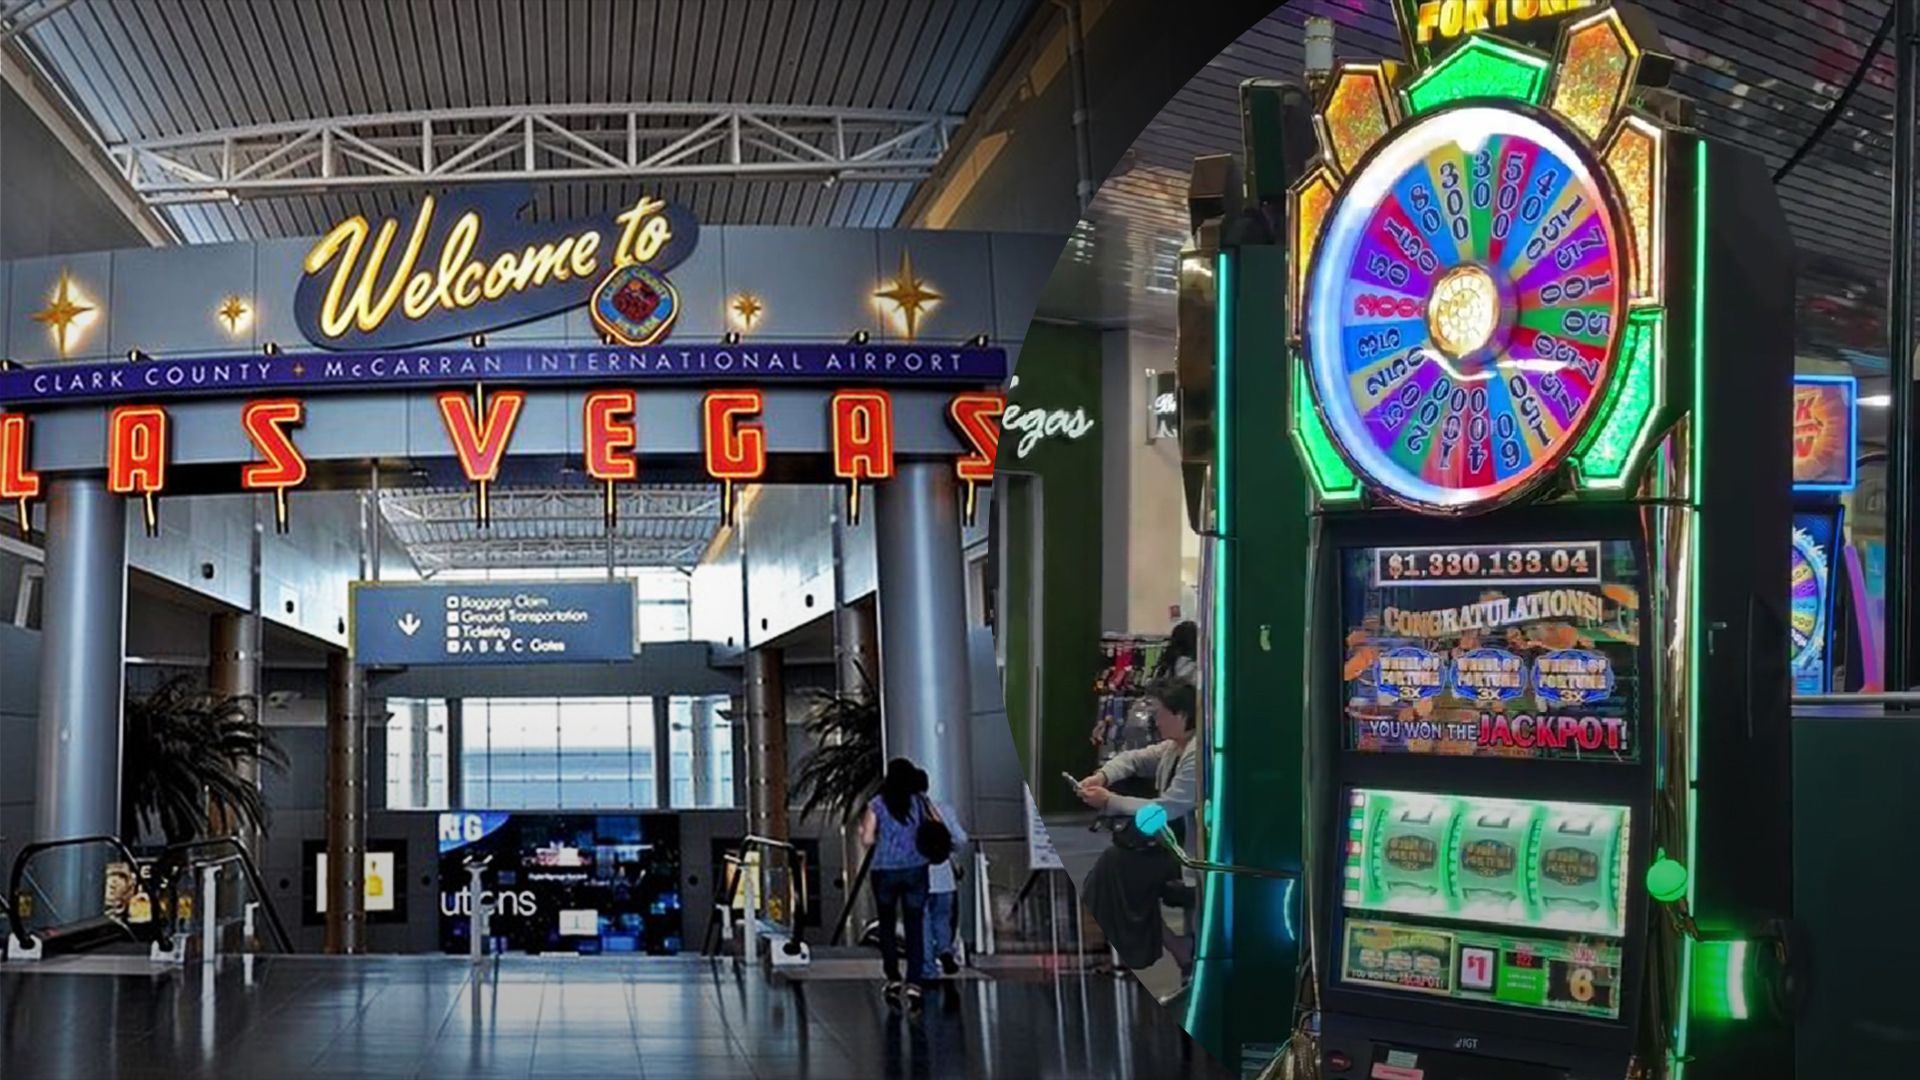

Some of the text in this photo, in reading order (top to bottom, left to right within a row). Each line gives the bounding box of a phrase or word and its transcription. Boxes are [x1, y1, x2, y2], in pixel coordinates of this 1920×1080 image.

[1417, 0, 1596, 43] FORTU
[1440, 161, 1469, 241] 300
[1472, 149, 1491, 209] 30
[1492, 152, 1526, 239] 500
[1520, 168, 1558, 224] 40
[1410, 184, 1441, 234] 80
[1526, 194, 1584, 260] 150
[304, 195, 601, 338] Welcome
[616, 195, 672, 267] to
[1366, 250, 1409, 287] 50
[1384, 217, 1438, 274] 150
[1556, 226, 1606, 270] 75
[1540, 271, 1611, 304] 100
[1358, 328, 1400, 357] 35
[1563, 309, 1611, 336] 50
[34, 351, 962, 394] CLARK COUNTY McCARRAN INTERNATIONAL AIRPORT
[1366, 346, 1426, 396] 250
[1002, 375, 1095, 458] egas
[1382, 383, 1420, 431] 50
[1405, 377, 1451, 454] 200
[1509, 374, 1552, 447] 150
[1541, 372, 1580, 421] 75
[0, 388, 1006, 498] LAS VEGAS
[1440, 387, 1467, 470] 100
[1469, 387, 1488, 474] 400
[1496, 413, 1521, 468] 60
[461, 596, 512, 610] Baggage
[461, 610, 588, 624] Ground Transportation
[1385, 590, 1603, 637] CONGRATULATIONS!
[462, 641, 473, 652] A
[480, 641, 488, 652] B
[512, 640, 523, 652] C
[530, 639, 565, 652] Gates
[1399, 687, 1421, 699] 3X
[1477, 688, 1500, 700] 3X
[1560, 690, 1585, 702] 3X
[1370, 712, 1629, 751] YOU WON THE JACKPOT!
[440, 886, 538, 917] utons
[1467, 954, 1488, 981] $1
[1570, 968, 1595, 1002] 6
[1462, 1037, 1479, 1049] IGT
